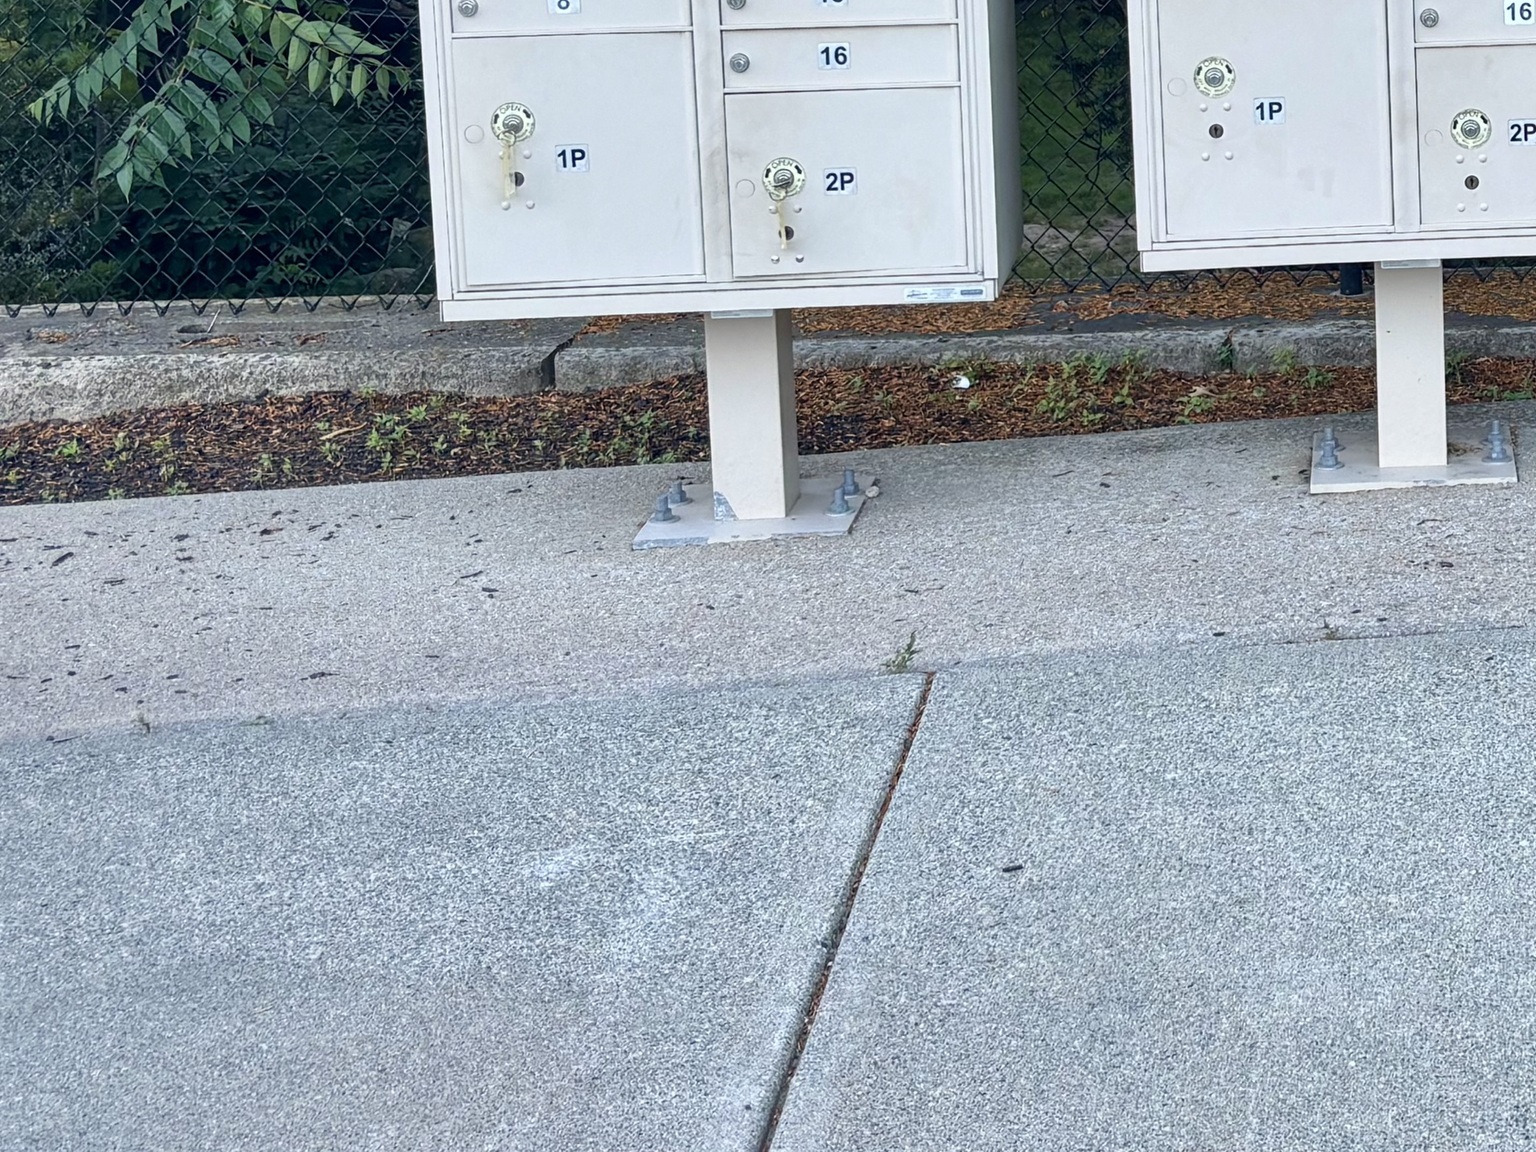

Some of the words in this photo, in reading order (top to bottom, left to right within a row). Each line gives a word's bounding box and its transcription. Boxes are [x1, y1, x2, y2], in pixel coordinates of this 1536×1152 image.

[1506, 2, 1532, 21] 16
[820, 46, 848, 66] 16
[1255, 101, 1283, 121] 1P
[557, 148, 586, 169] 1P
[825, 171, 855, 192] 2P
